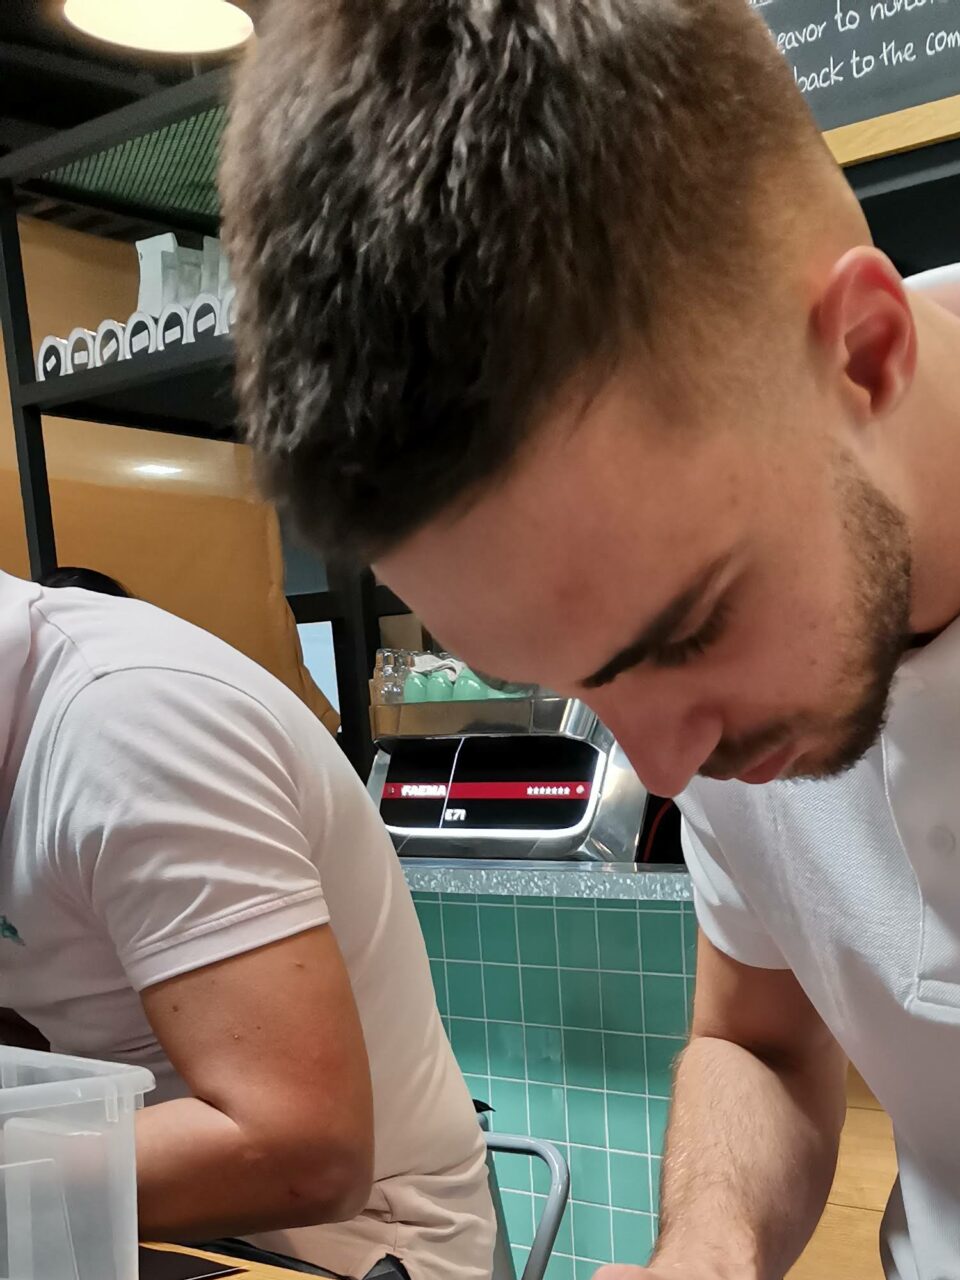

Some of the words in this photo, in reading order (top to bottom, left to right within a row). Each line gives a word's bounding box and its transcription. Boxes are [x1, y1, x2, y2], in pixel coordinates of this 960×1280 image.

[768, 21, 827, 55] eavor
[834, 0, 860, 32] to
[794, 56, 844, 92] back
[850, 49, 875, 79] to
[879, 39, 917, 67] the
[401, 784, 447, 797] FAEMA
